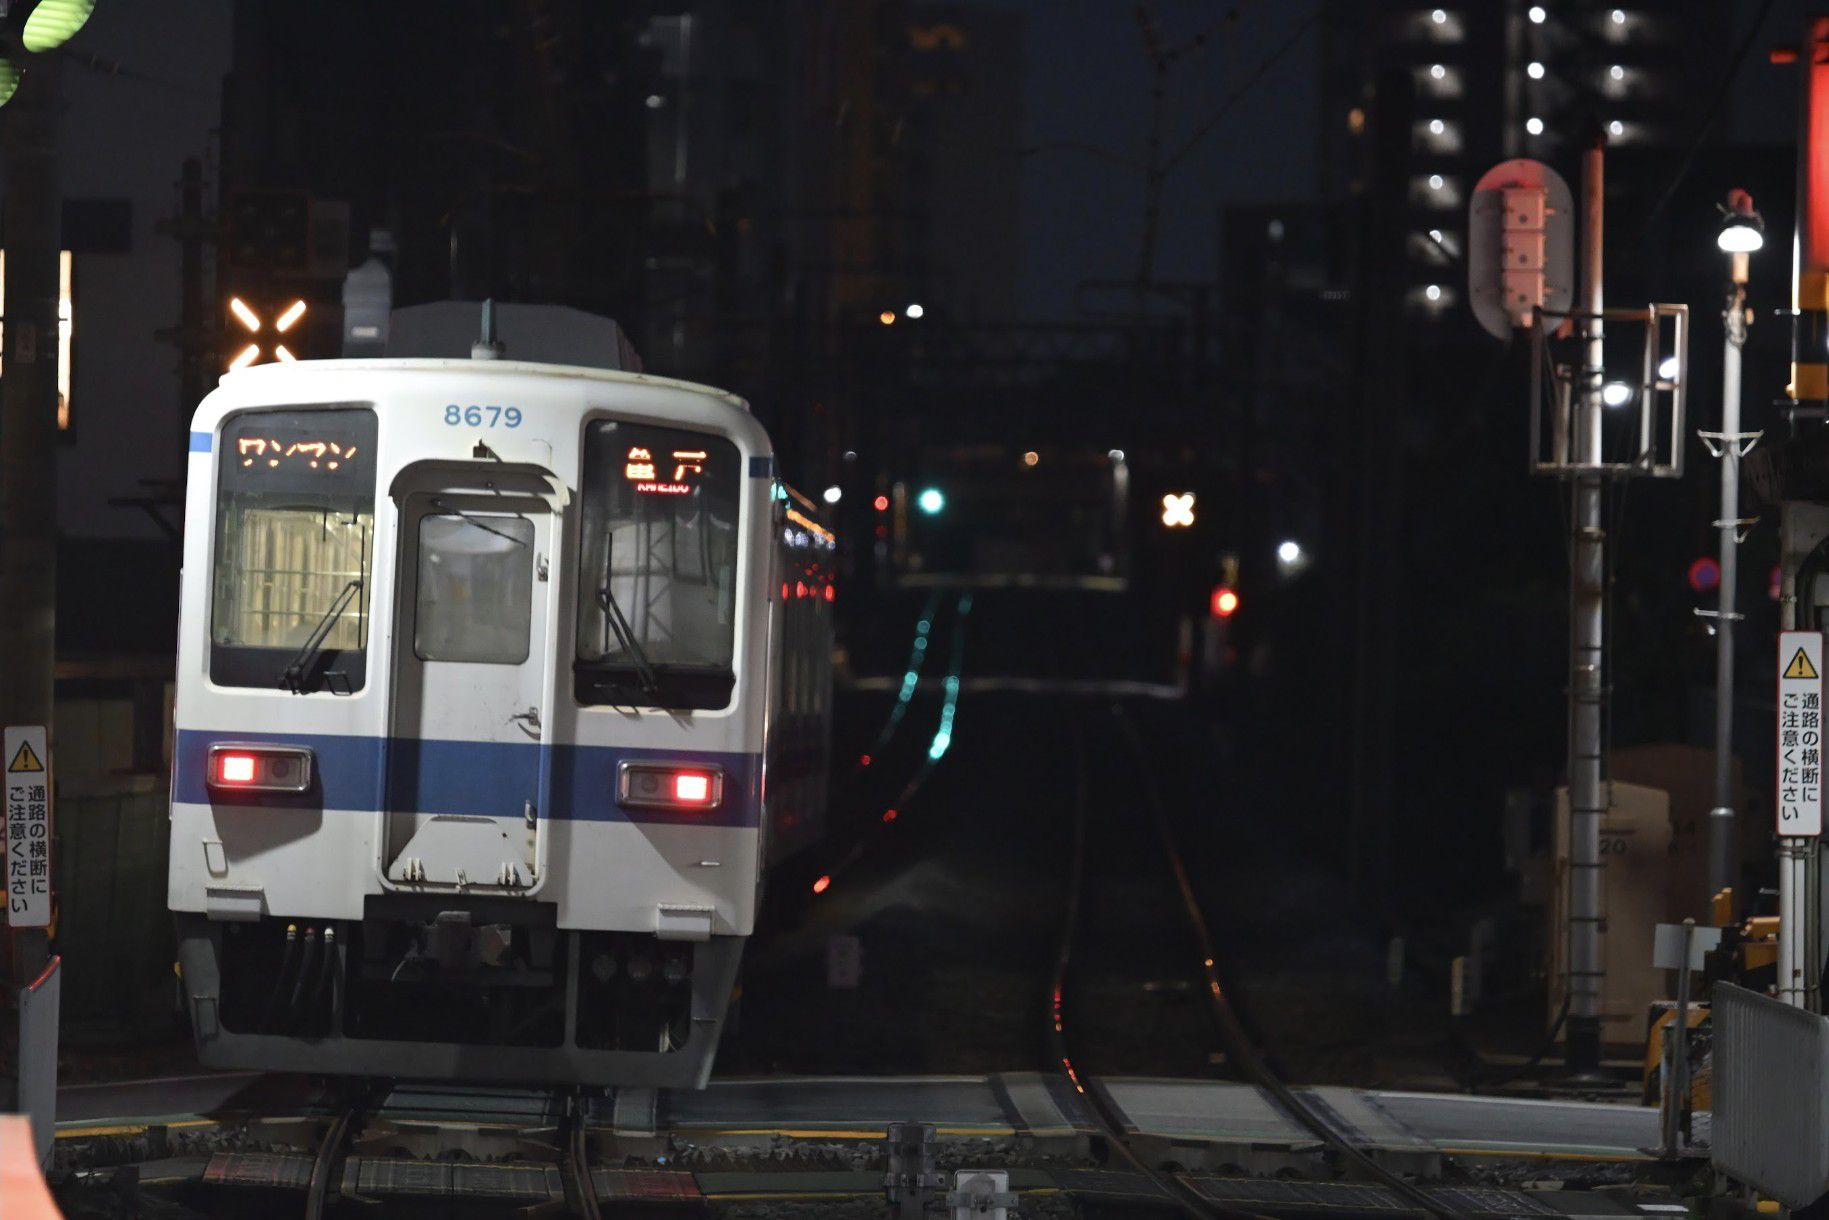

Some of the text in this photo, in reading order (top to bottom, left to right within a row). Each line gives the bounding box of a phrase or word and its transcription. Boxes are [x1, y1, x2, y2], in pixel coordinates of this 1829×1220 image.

[444, 404, 522, 429] 8679
[1782, 693, 1799, 820] ご注意ください
[1801, 693, 1819, 803] 通路の横断に
[9, 786, 28, 913] ご注意ください
[28, 785, 47, 895] 通路の横断に
